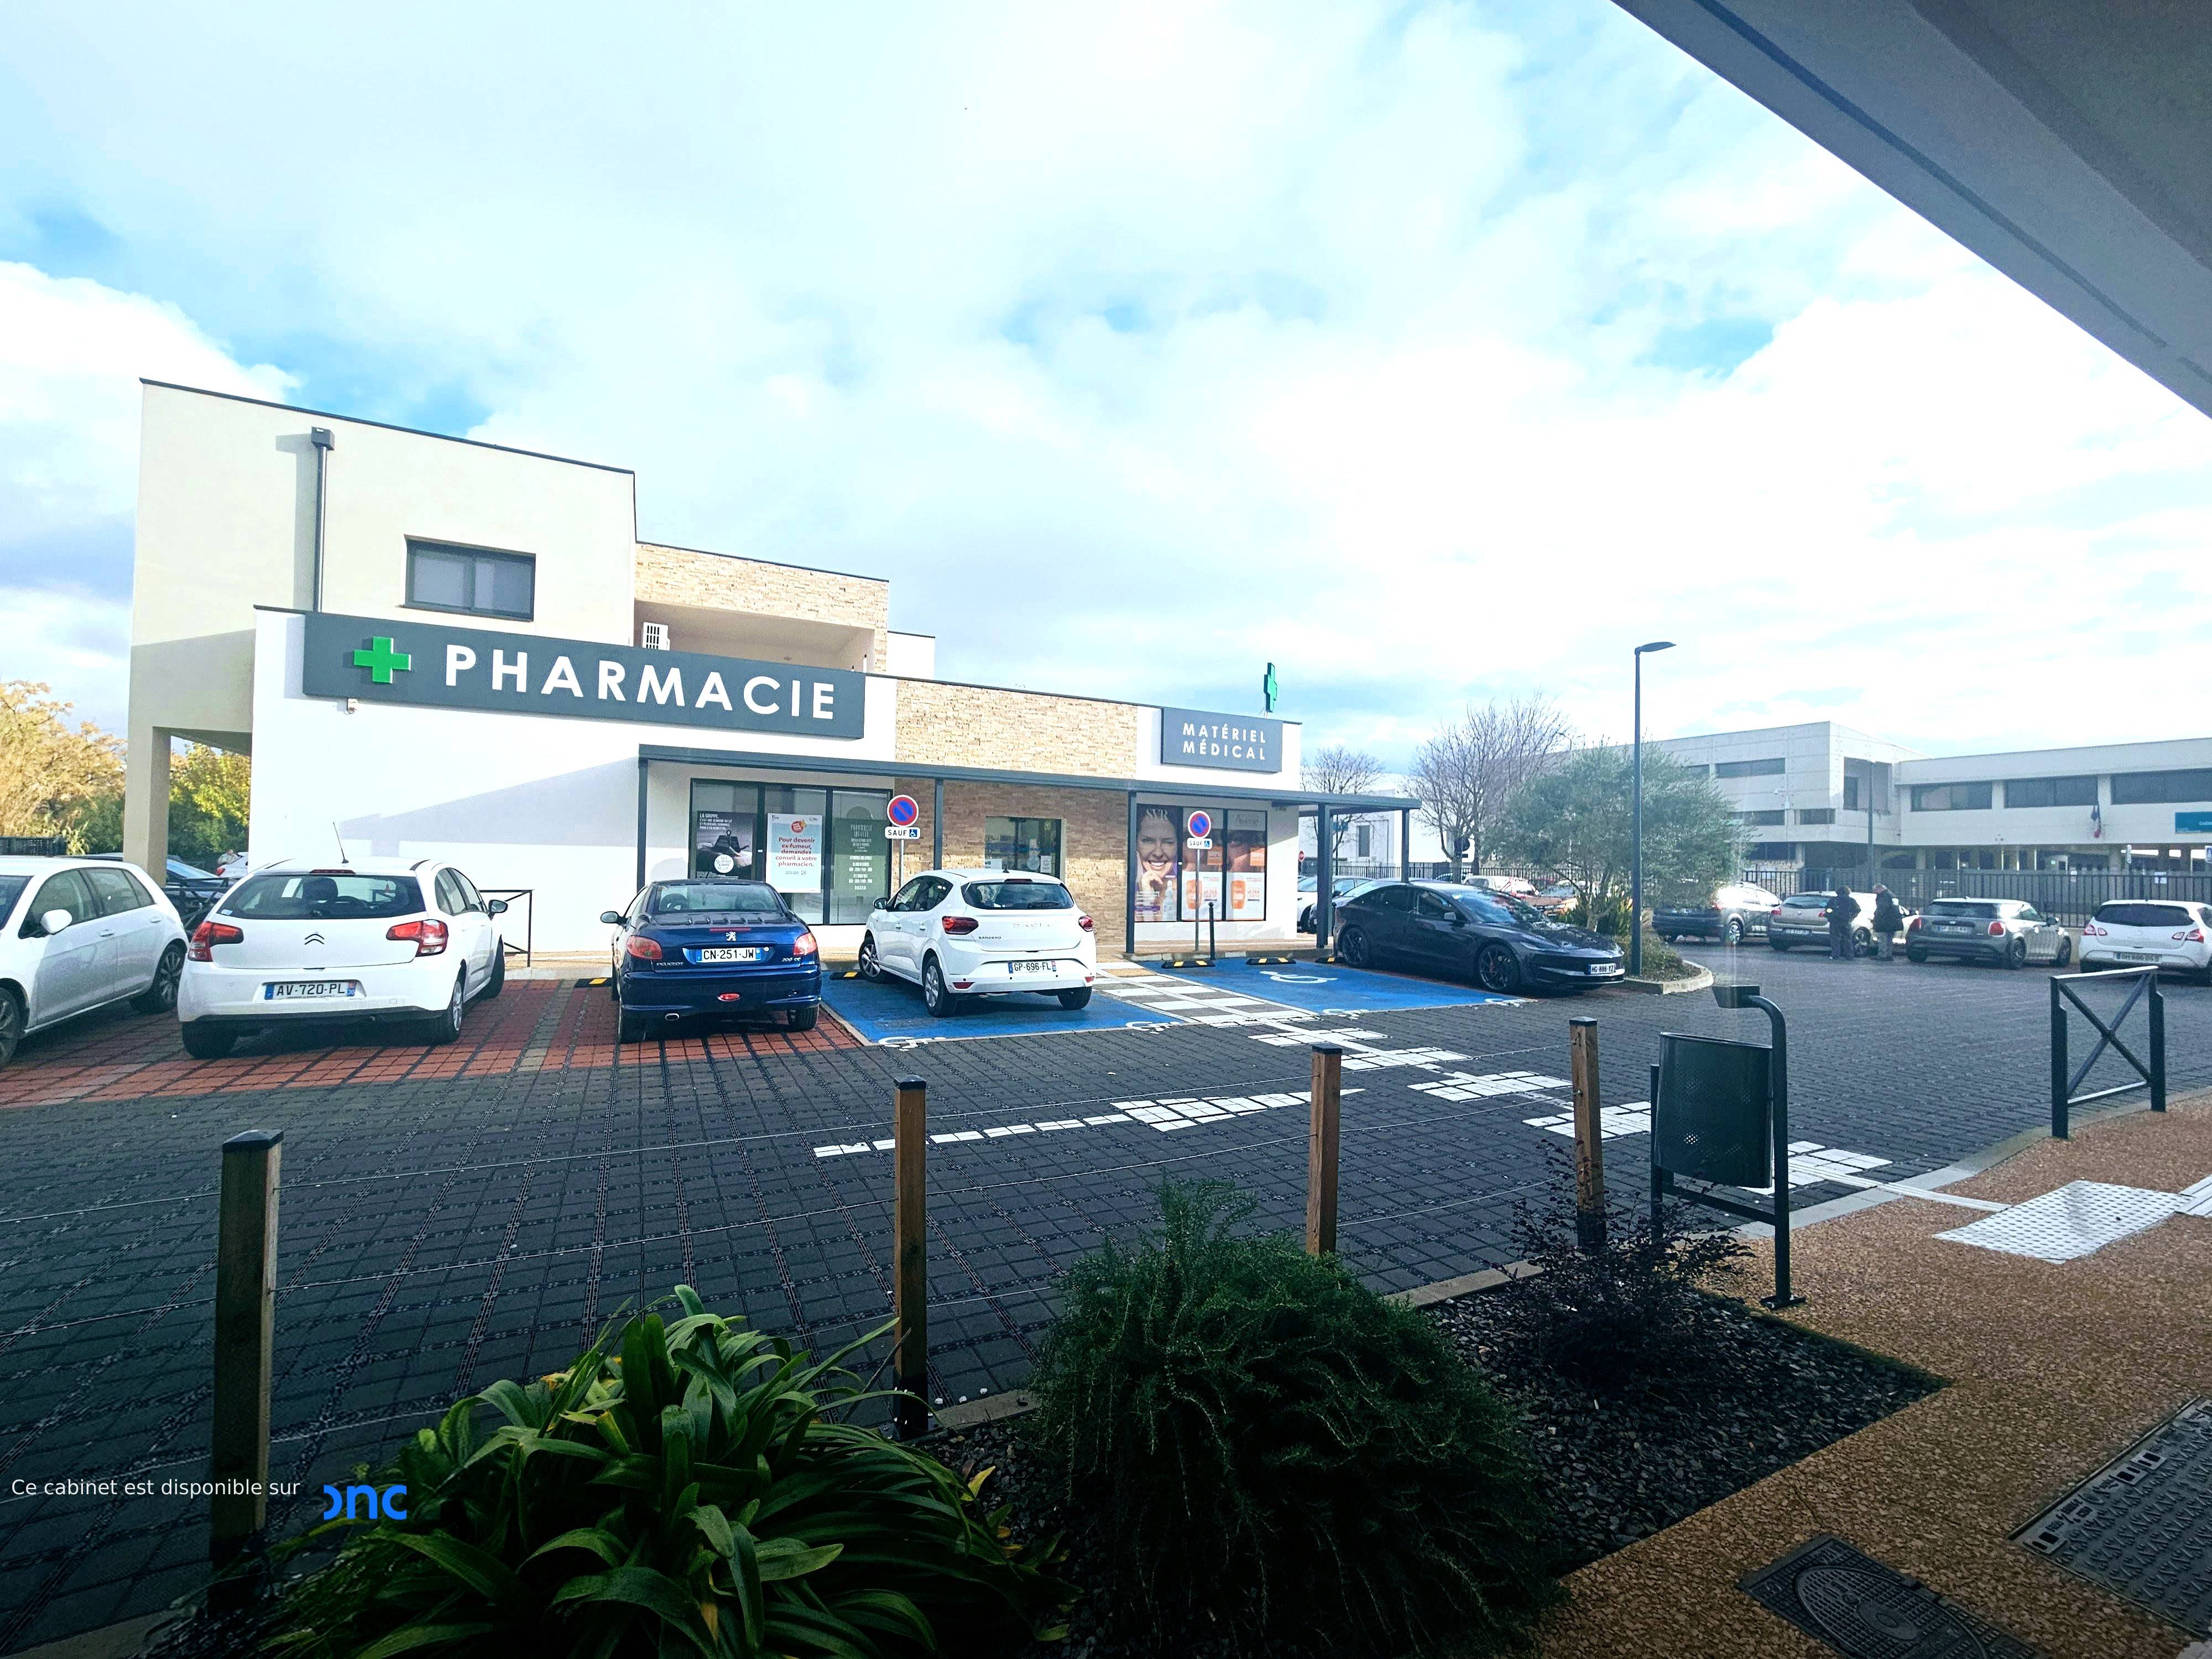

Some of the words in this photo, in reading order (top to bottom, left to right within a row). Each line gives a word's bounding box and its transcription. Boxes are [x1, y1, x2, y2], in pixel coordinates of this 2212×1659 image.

[446, 644, 833, 719] PHARMACIE
[1183, 723, 1266, 743] MATÉRIEL
[1183, 739, 1265, 760] MÉDICAL
[1146, 808, 1168, 821] SVR
[703, 949, 754, 960] CN-251-JW
[1014, 962, 1051, 972] GP-696-FL
[276, 983, 345, 996] AV-720-PL
